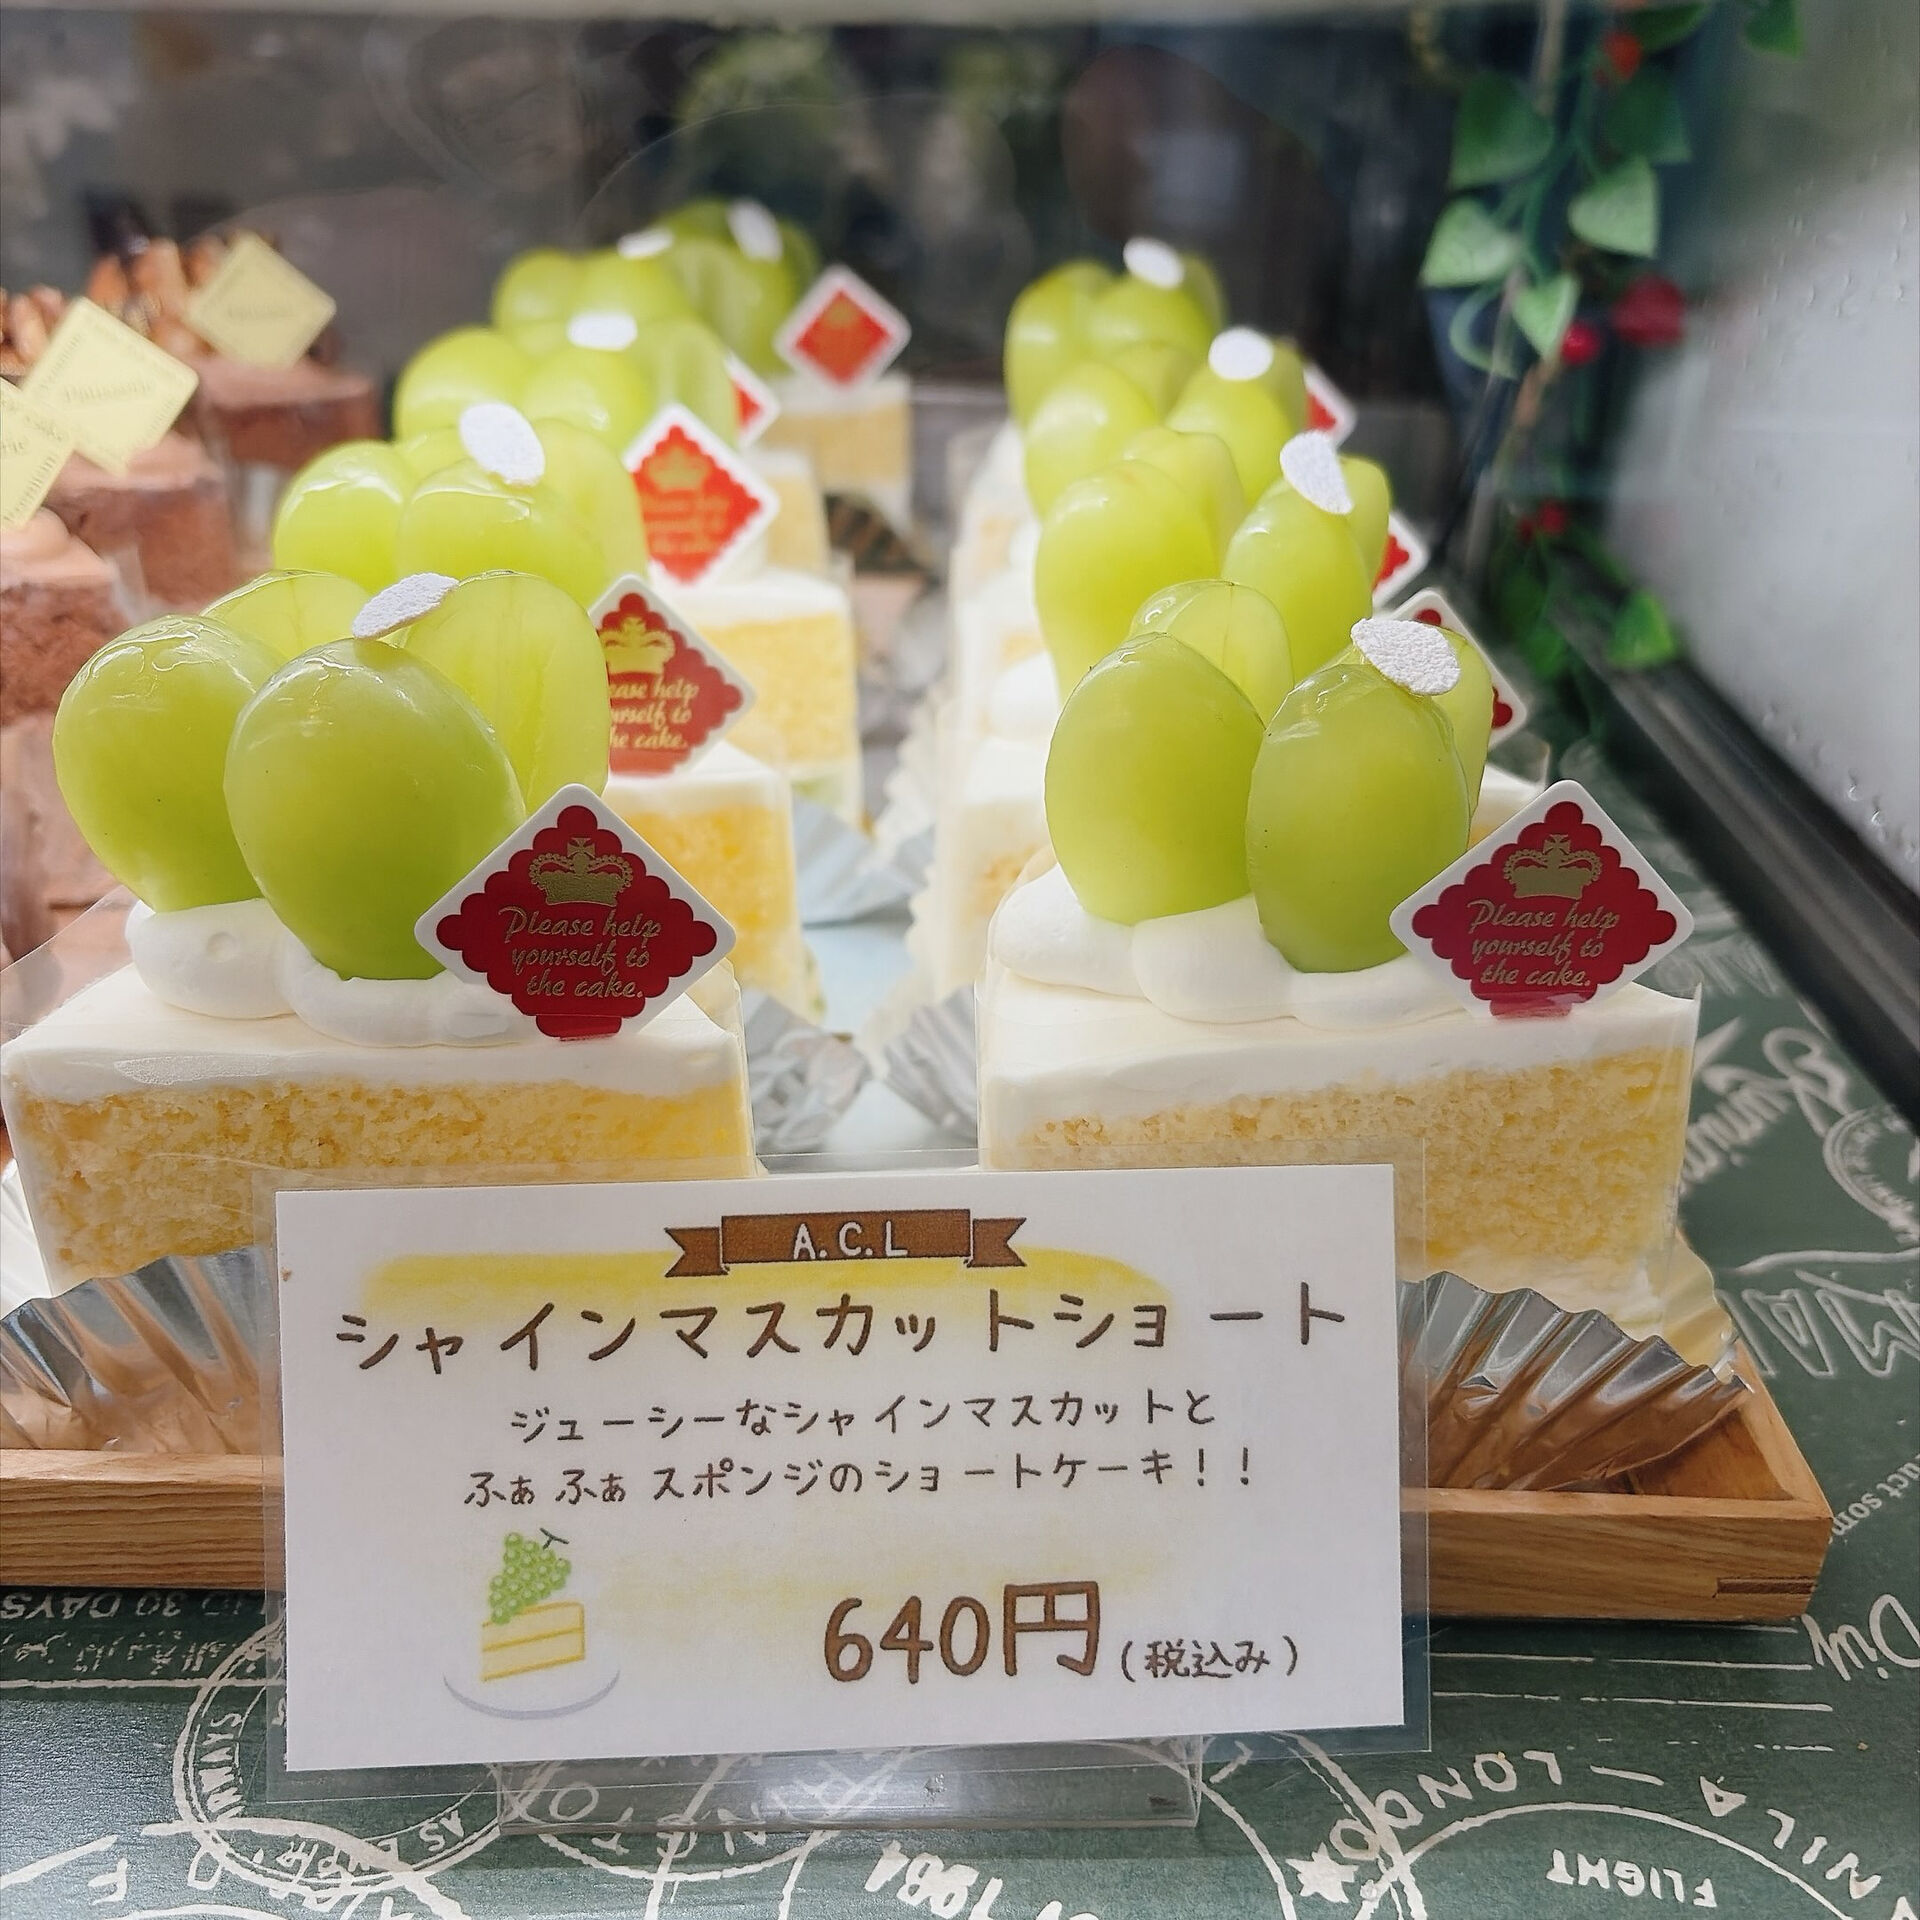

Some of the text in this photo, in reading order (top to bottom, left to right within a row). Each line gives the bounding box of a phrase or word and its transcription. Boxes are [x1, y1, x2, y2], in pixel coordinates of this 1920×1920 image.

[652, 673, 700, 709] help
[671, 704, 693, 725] to
[609, 724, 630, 749] he
[498, 906, 662, 947] Please help
[1467, 899, 1620, 938] Please help
[511, 941, 651, 976] yourself to
[1471, 931, 1605, 967] yourself to
[526, 968, 645, 999] the cake.
[1480, 958, 1591, 986] the cake.
[792, 1219, 910, 1261] A.C.L
[336, 1281, 1346, 1374] シャインマスカットショート
[511, 1388, 1215, 1444] ジューシーなシャインマスカットと
[1876, 1453, 1920, 1498] uct
[823, 1580, 1102, 1685] 640円
[1545, 1849, 1719, 1909] FLIGHT
